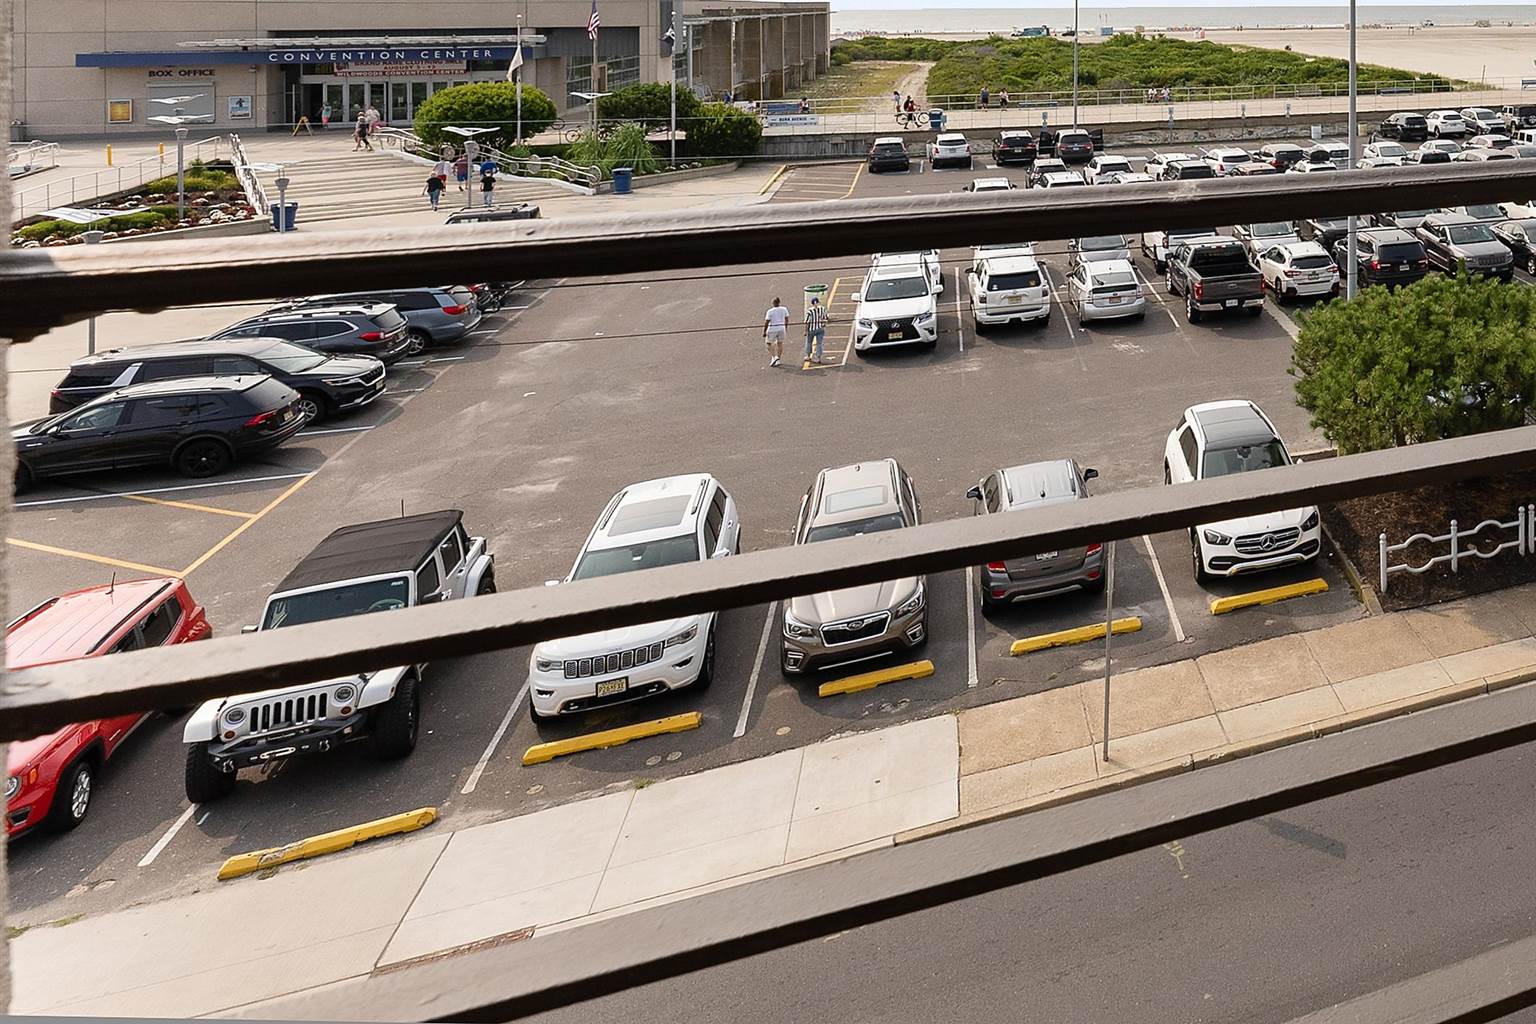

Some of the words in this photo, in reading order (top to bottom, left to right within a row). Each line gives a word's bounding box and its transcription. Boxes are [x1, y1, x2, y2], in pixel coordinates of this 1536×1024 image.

[268, 51, 405, 62] CONVENTION
[420, 49, 492, 59] CENTER
[178, 69, 216, 77] OFFICE
